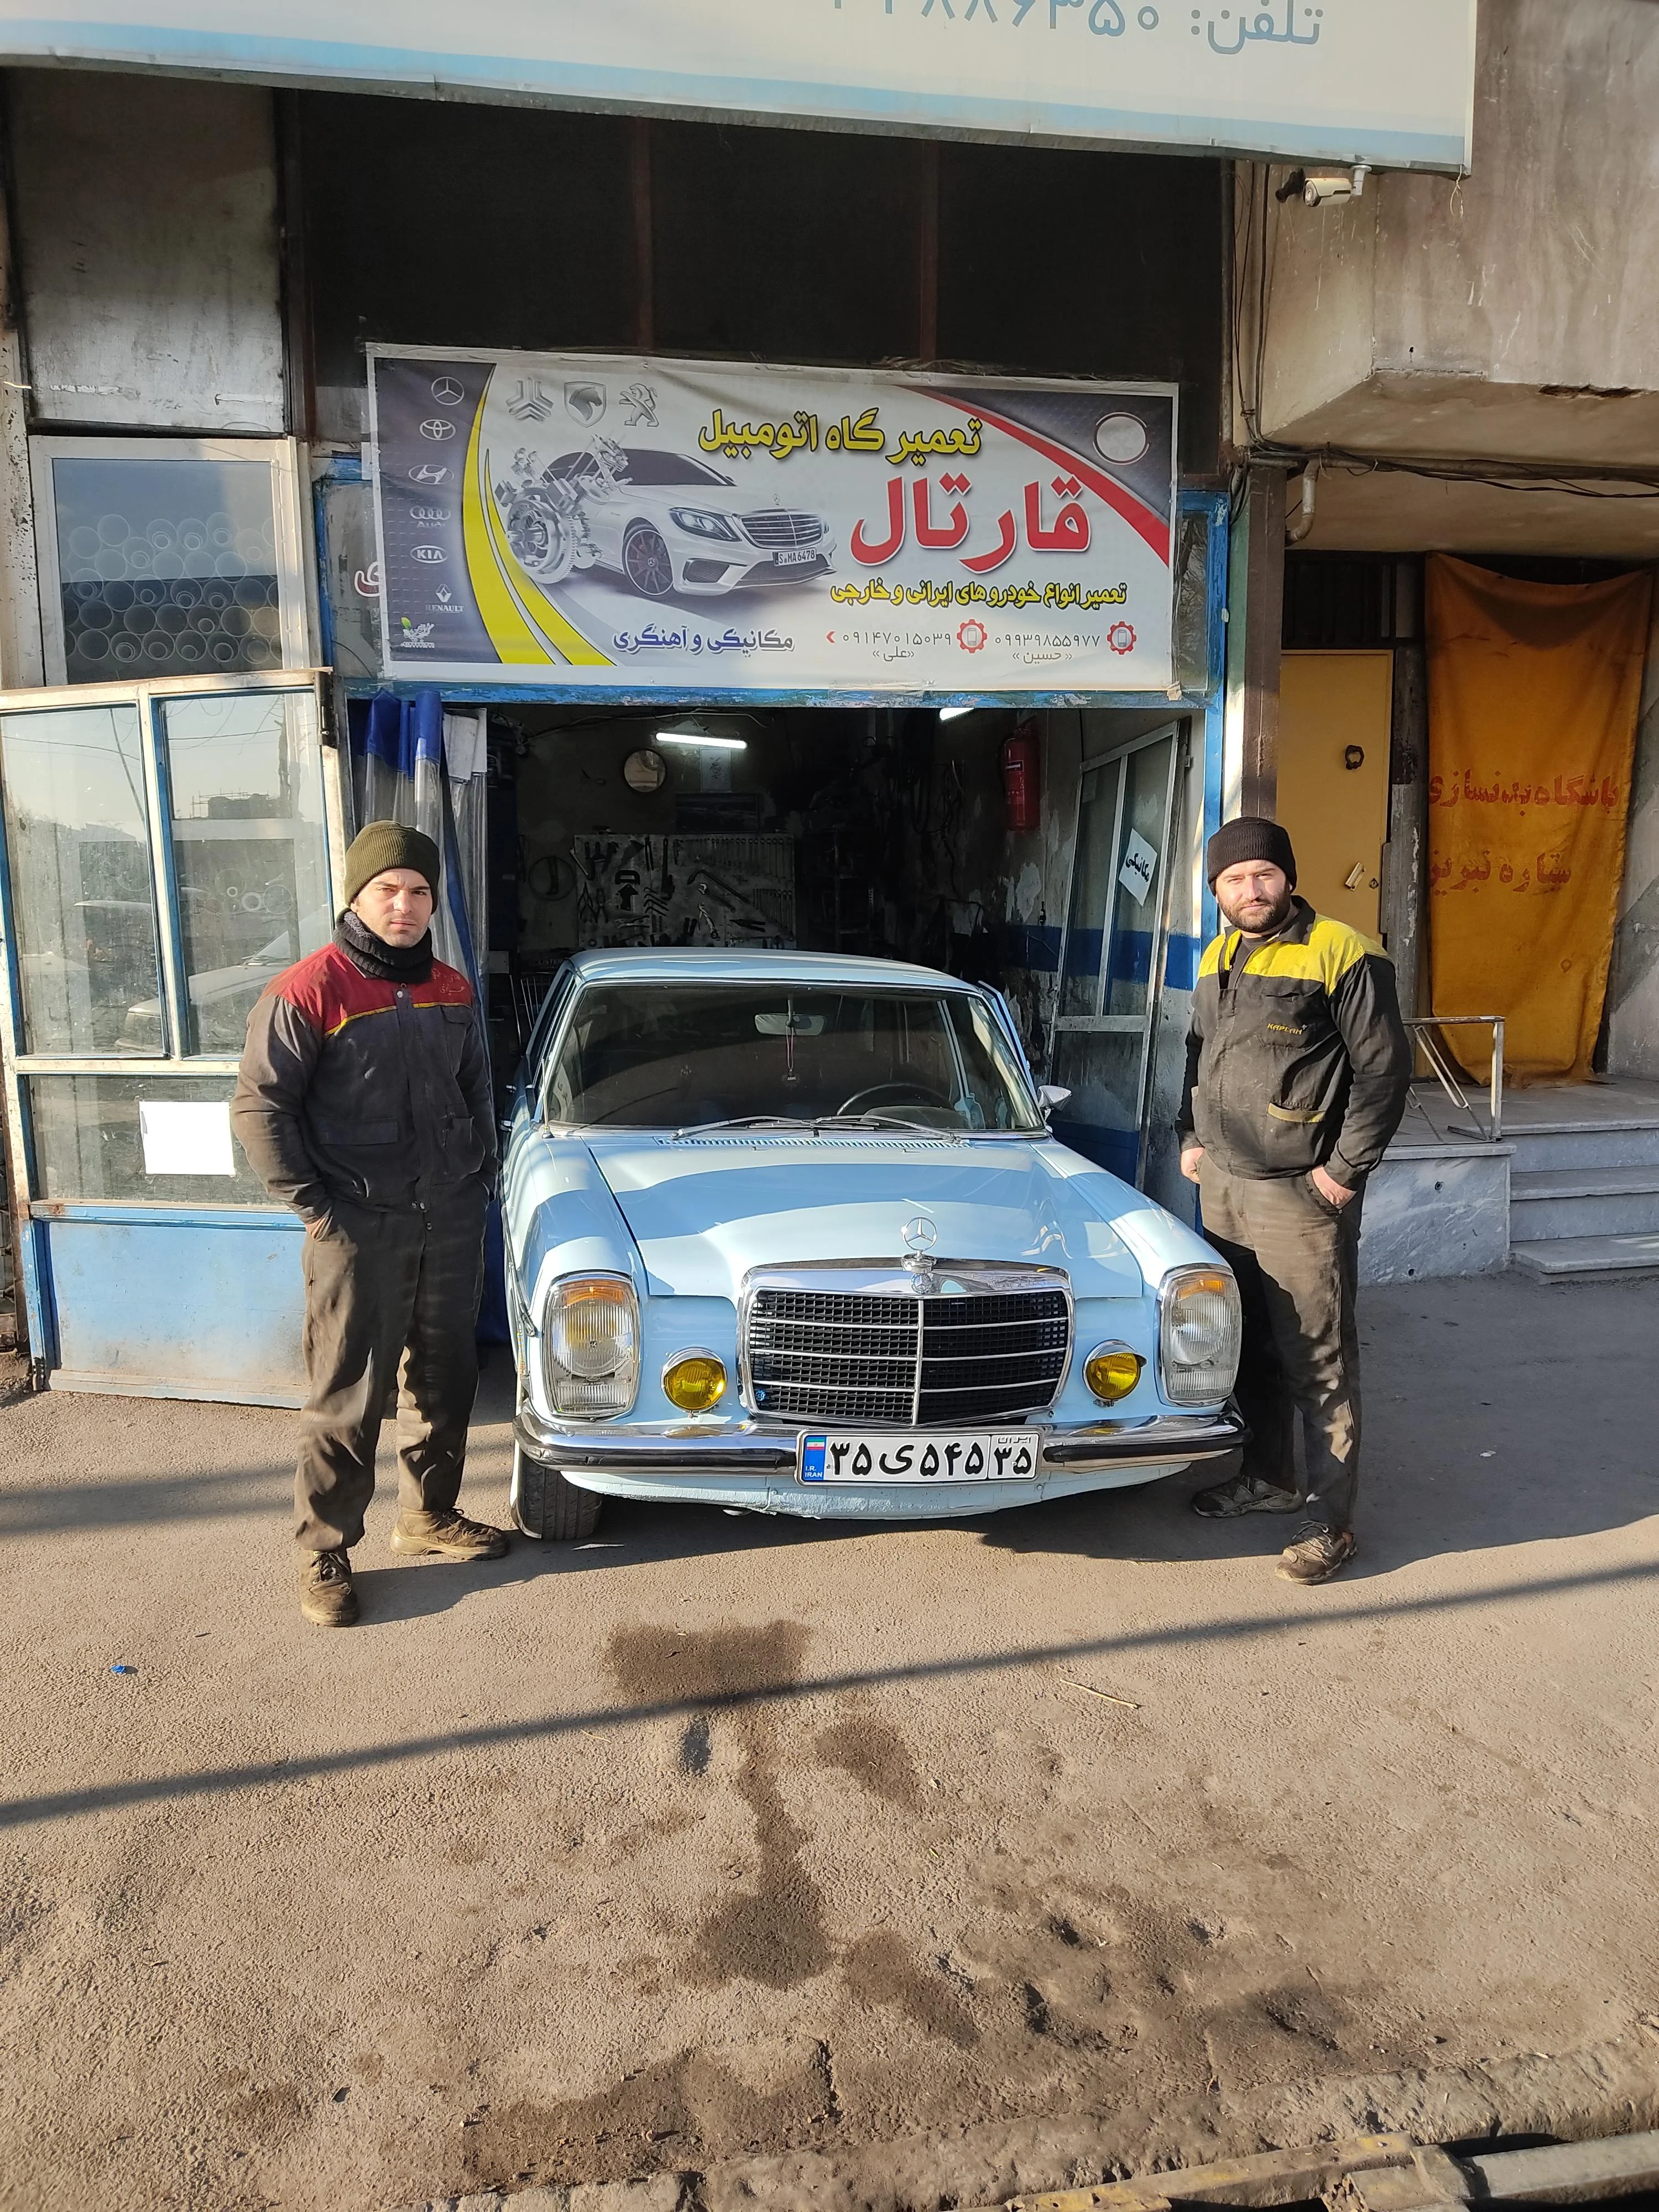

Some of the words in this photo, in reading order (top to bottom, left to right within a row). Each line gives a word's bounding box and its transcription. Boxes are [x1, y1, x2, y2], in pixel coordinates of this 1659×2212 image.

[698, 408, 818, 460] اتومبیل
[416, 549, 443, 560] KIA
[831, 577, 890, 606] خارجی
[890, 584, 904, 606] و
[906, 580, 953, 608] ایرانی
[1044, 581, 1079, 609] انواع
[1079, 582, 1128, 610] تعمیر
[425, 604, 464, 612] RENAULT
[614, 623, 689, 655] آهنگری
[690, 634, 703, 655] و
[707, 628, 795, 658] مکانیکی
[843, 632, 951, 645] ۰۹۱۴۷۰۱۵۰۳۹
[995, 634, 1100, 647] ۰۹۹۳۹۸۵۵۹۷۷
[1267, 1023, 1303, 1035] KAPLAN
[993, 1446, 1032, 1476] ۳۵
